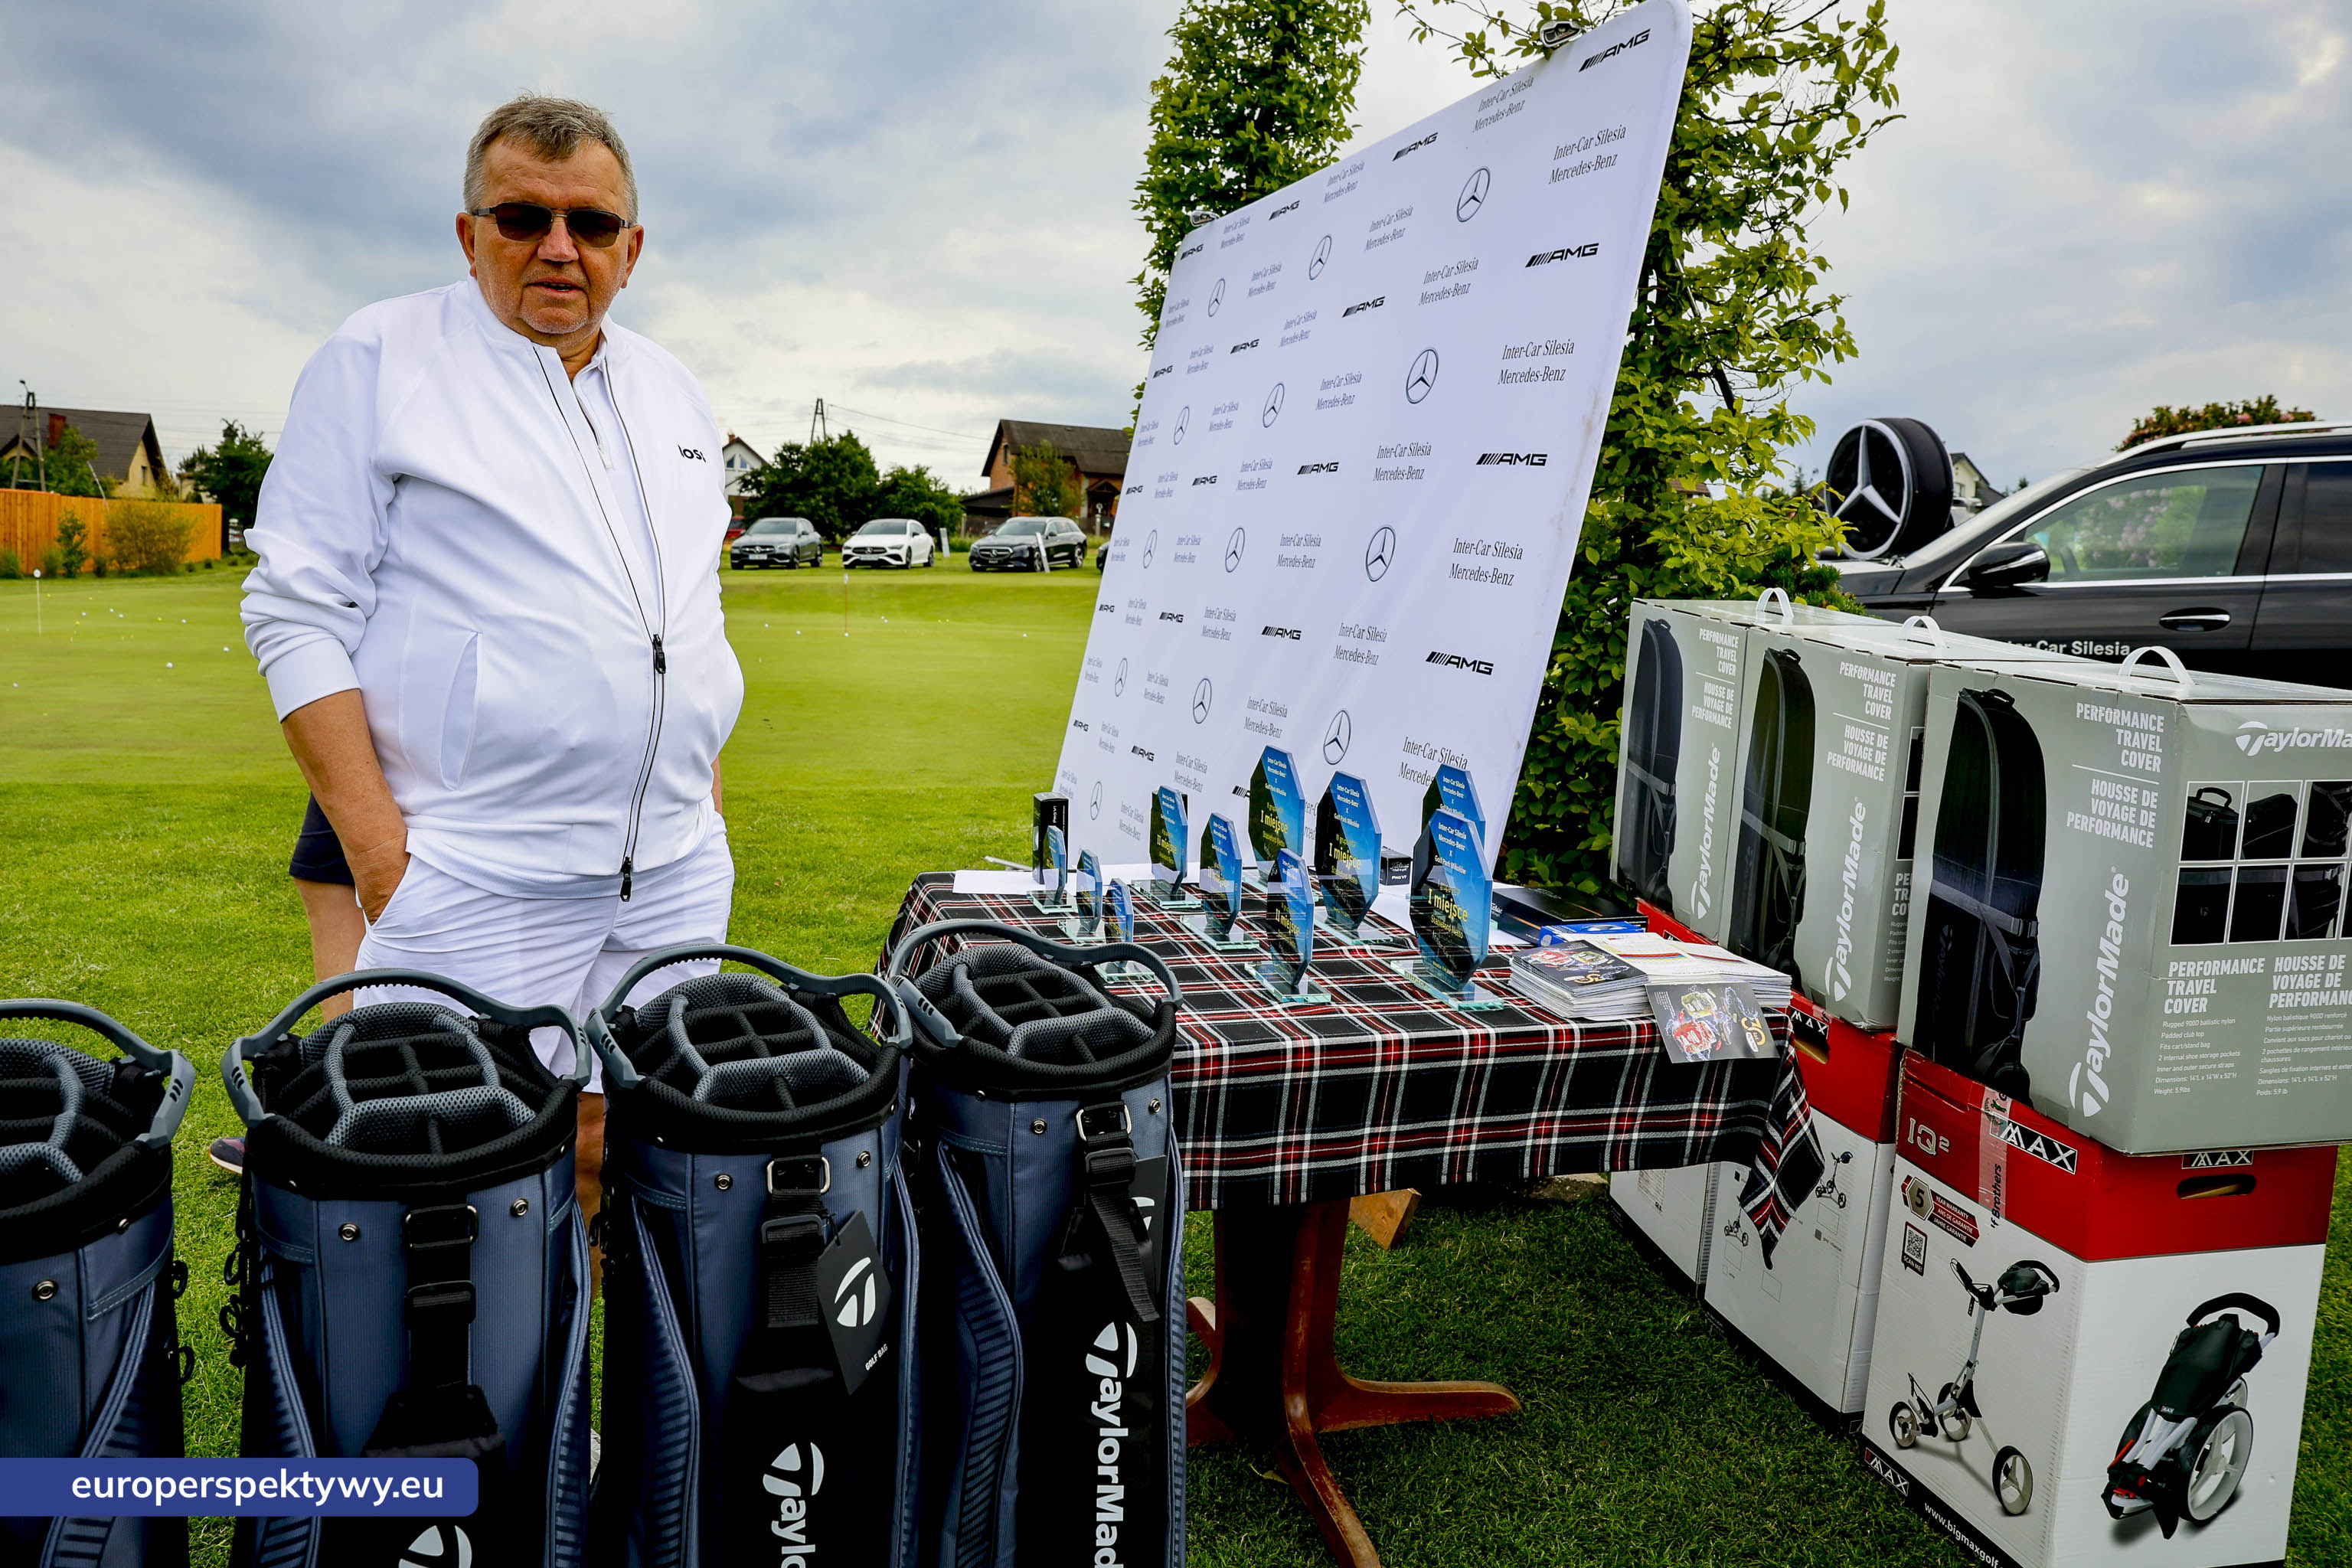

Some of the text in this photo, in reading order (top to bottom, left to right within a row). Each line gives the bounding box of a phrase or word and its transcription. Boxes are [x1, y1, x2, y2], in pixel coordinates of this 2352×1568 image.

[1601, 29, 1651, 61] AMG
[1479, 75, 1534, 111] Inter-Car Silesia
[1473, 99, 1525, 132] Mercedes-Benz
[1406, 132, 1439, 153] AMG
[1553, 124, 1627, 161] Inter-Car Silesia
[1549, 152, 1618, 185] Mercedes-Benz
[1547, 243, 1599, 261] AMG
[1423, 257, 1478, 284] Inter-Car Silesia
[1357, 296, 1385, 312] AMG
[1418, 281, 1471, 305] Mercedes-Benz
[1502, 339, 1574, 360] Inter-Car Silesia
[1498, 367, 1566, 384] Mercedes-Benz
[1377, 443, 1432, 459] Inter-Car Silesia
[1497, 453, 1547, 466] AMG
[1310, 462, 1338, 473] AMG
[1373, 466, 1425, 481] Mercedes-Benz
[1453, 537, 1523, 560] Inter-Car Silesia
[1449, 564, 1514, 586] Mercedes-Benz
[1274, 628, 1302, 640] AMG
[1338, 623, 1387, 643] Inter-Car Silesia
[1699, 628, 1739, 649] PERFORMANCE
[1333, 645, 1379, 666] Mercedes-Benz
[1717, 645, 1737, 663] TRAVEL
[2071, 641, 2130, 655] Silesia
[1445, 655, 1494, 675] AMG
[1718, 660, 1736, 677] COVER
[1839, 661, 1896, 688] PERFORMANCE
[1704, 681, 1734, 701] HOUSSE DE
[1863, 683, 1893, 704] TRAVEL
[1703, 694, 1733, 714] VOYAGE DE
[1864, 700, 1892, 721] COVER
[1691, 705, 1733, 730] PERFORMANCE
[2076, 703, 2164, 733] PERFORMANCE
[1844, 724, 1889, 750] HOUSSE DE
[2115, 728, 2163, 753] TRAVEL
[2236, 721, 2352, 756] TaylorMa
[1403, 737, 1468, 769] Inter-Car Silesia
[1844, 740, 1886, 767] VOYAGE DE
[2121, 750, 2161, 773] COVER
[1827, 752, 1885, 782] PERFORMANCE
[2092, 779, 2158, 809] HOUSSE DE
[1261, 810, 1264, 822] I
[1265, 813, 1288, 833] miejsce
[2091, 798, 2156, 829] VOYAGE DE
[1690, 746, 1721, 919] TaylorMade
[2066, 812, 2154, 849] PERFORMANCE
[1329, 842, 1361, 870] I miejsce
[1428, 888, 1433, 904] I
[1434, 894, 1468, 923] miejsce
[1825, 802, 1867, 1001] TaylorMade
[1281, 914, 1300, 936] miejsce
[2168, 958, 2265, 977] PERFORMANCE
[2274, 954, 2347, 972] HOUSSE DE
[2167, 978, 2217, 995] TRAVEL
[2272, 972, 2343, 990] VOYAGE DE
[2069, 873, 2129, 1117] TaylorMade
[2164, 997, 2208, 1014] COVER
[2269, 990, 2352, 1008] PERFORMAN
[1915, 1188, 1925, 1208] 5
[1991, 1164, 2001, 1219] Brothers
[1936, 1195, 1969, 1220] YEAR WARRANTY
[1933, 1217, 1967, 1242] JAHRE GARANTIE
[1952, 1217, 1973, 1234] GARANTIE
[1903, 1255, 1922, 1272] SCAN ME!
[865, 1343, 888, 1371] GOLF BAG
[1086, 1321, 1138, 1568] TaylorMad
[763, 1442, 825, 1568] Taylo
[1924, 1502, 2001, 1568] www.bigmaxgolf
